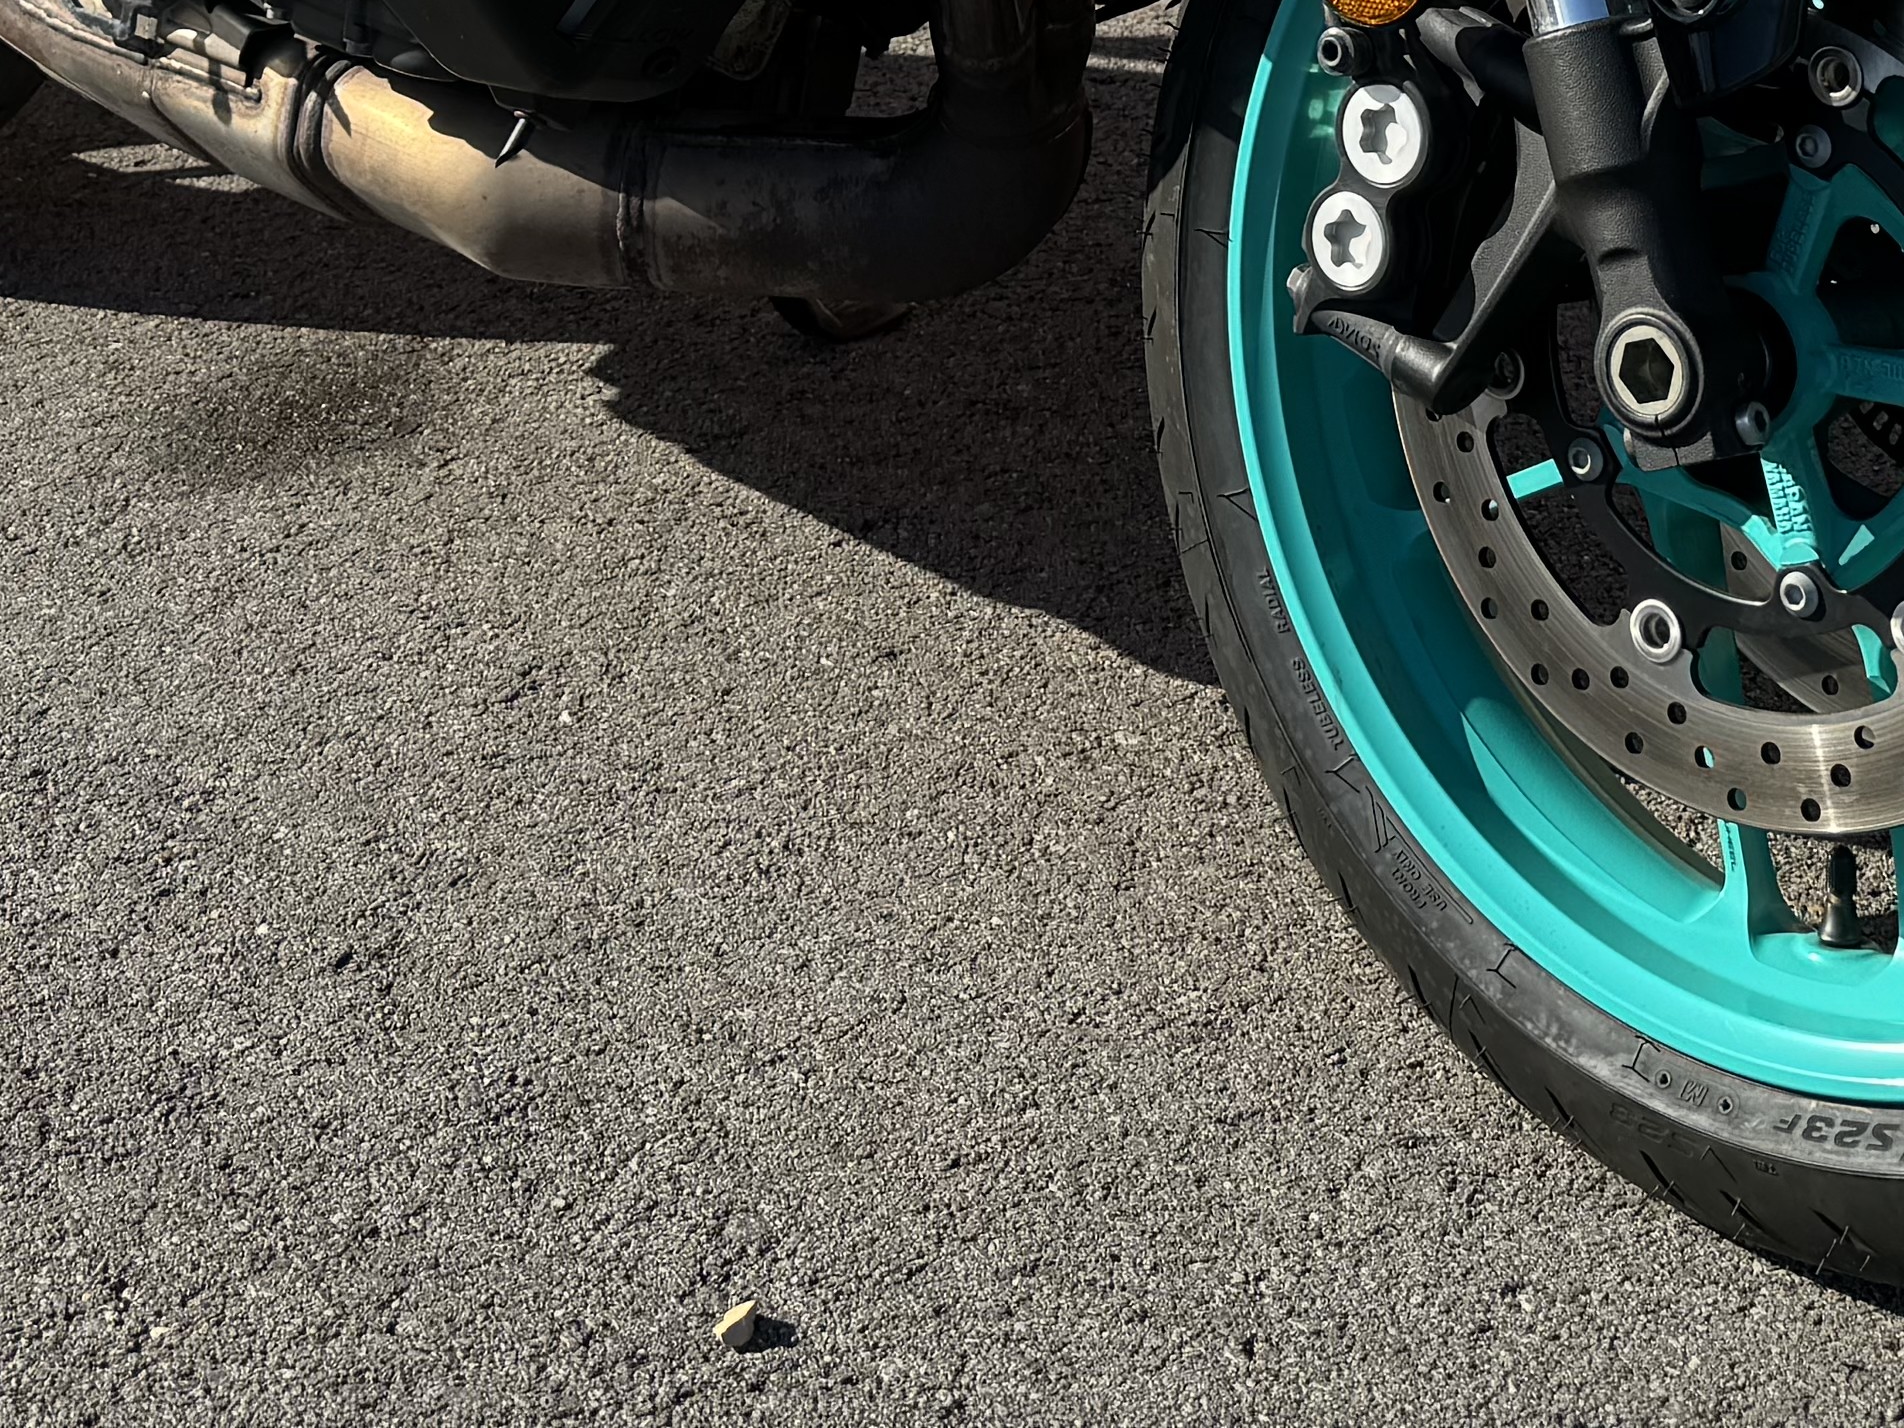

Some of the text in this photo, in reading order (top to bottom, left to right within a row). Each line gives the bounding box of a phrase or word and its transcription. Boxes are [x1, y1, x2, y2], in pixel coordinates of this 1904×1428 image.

[1256, 566, 1291, 635] RADIAL
[1291, 656, 1344, 751] TUBELESS
[1392, 849, 1448, 912] USE ONLY
[1392, 867, 1427, 910] FRONT
[1772, 1112, 1902, 1152] S23F
